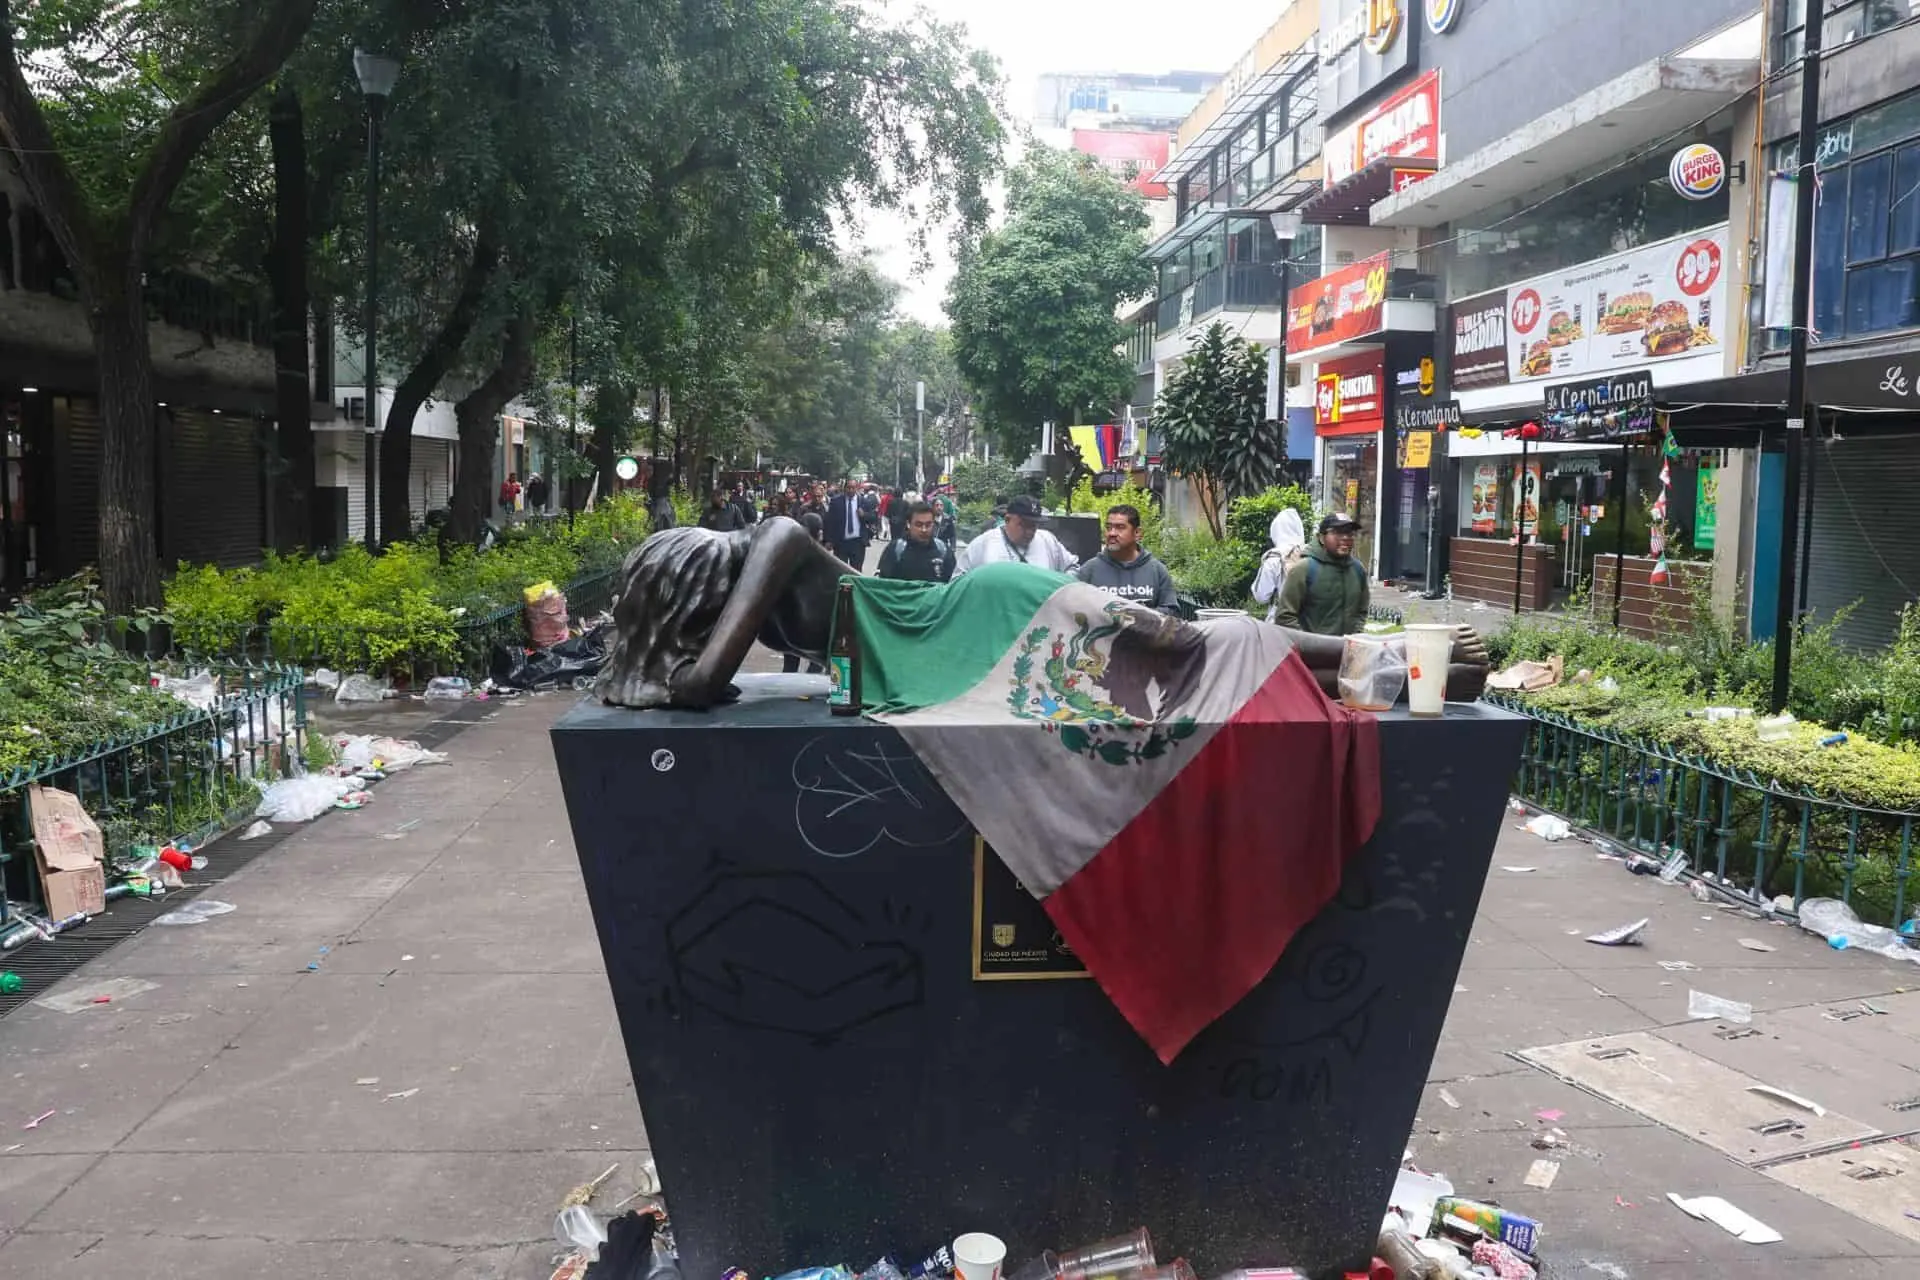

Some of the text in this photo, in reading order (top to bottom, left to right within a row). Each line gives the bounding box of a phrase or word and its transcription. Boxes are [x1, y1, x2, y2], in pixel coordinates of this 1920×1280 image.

[1683, 153, 1718, 173] BURGER
[1685, 161, 1721, 186] KING
[1339, 375, 1373, 400] SUKIYA
[1880, 366, 1908, 396] La
